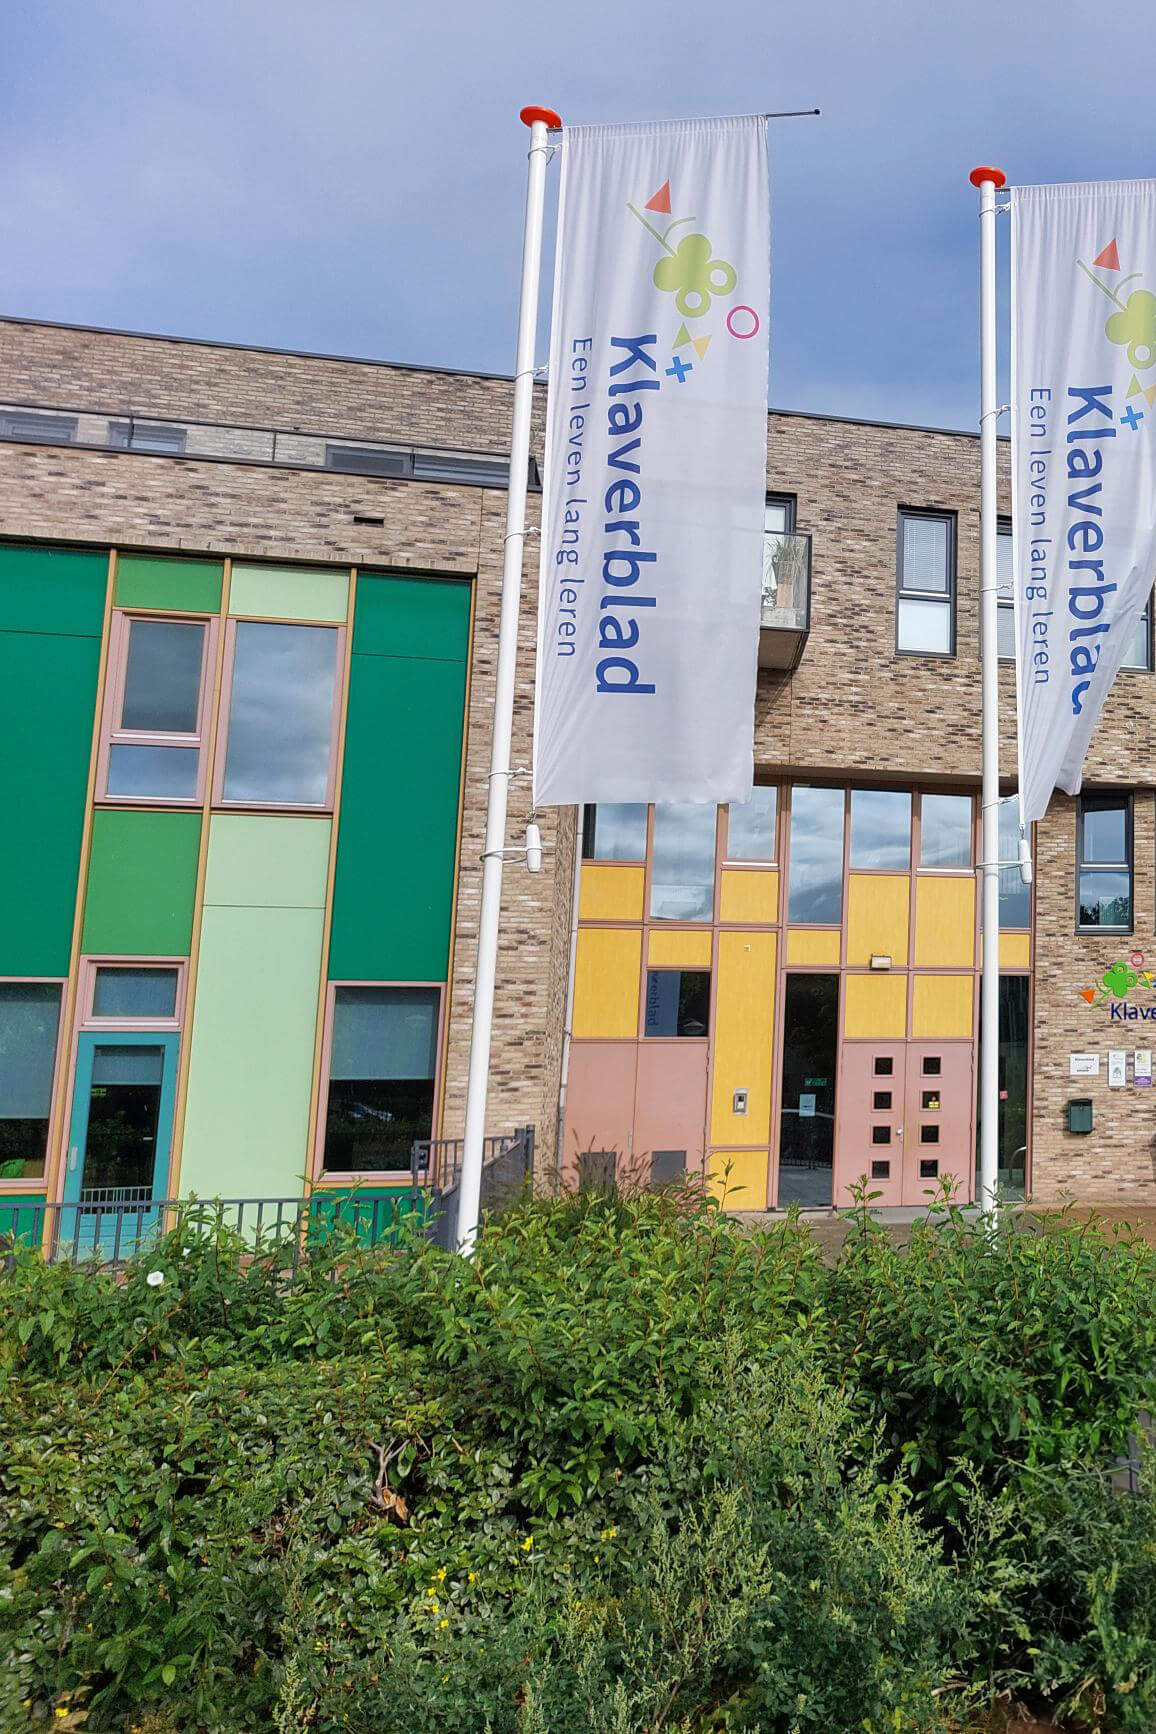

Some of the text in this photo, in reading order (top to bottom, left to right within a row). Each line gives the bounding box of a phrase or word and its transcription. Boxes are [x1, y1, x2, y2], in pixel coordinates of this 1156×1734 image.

[556, 337, 593, 657] Een leven lang leren
[595, 334, 661, 694] Klaverblad
[1025, 388, 1054, 684] Een leven lang leren
